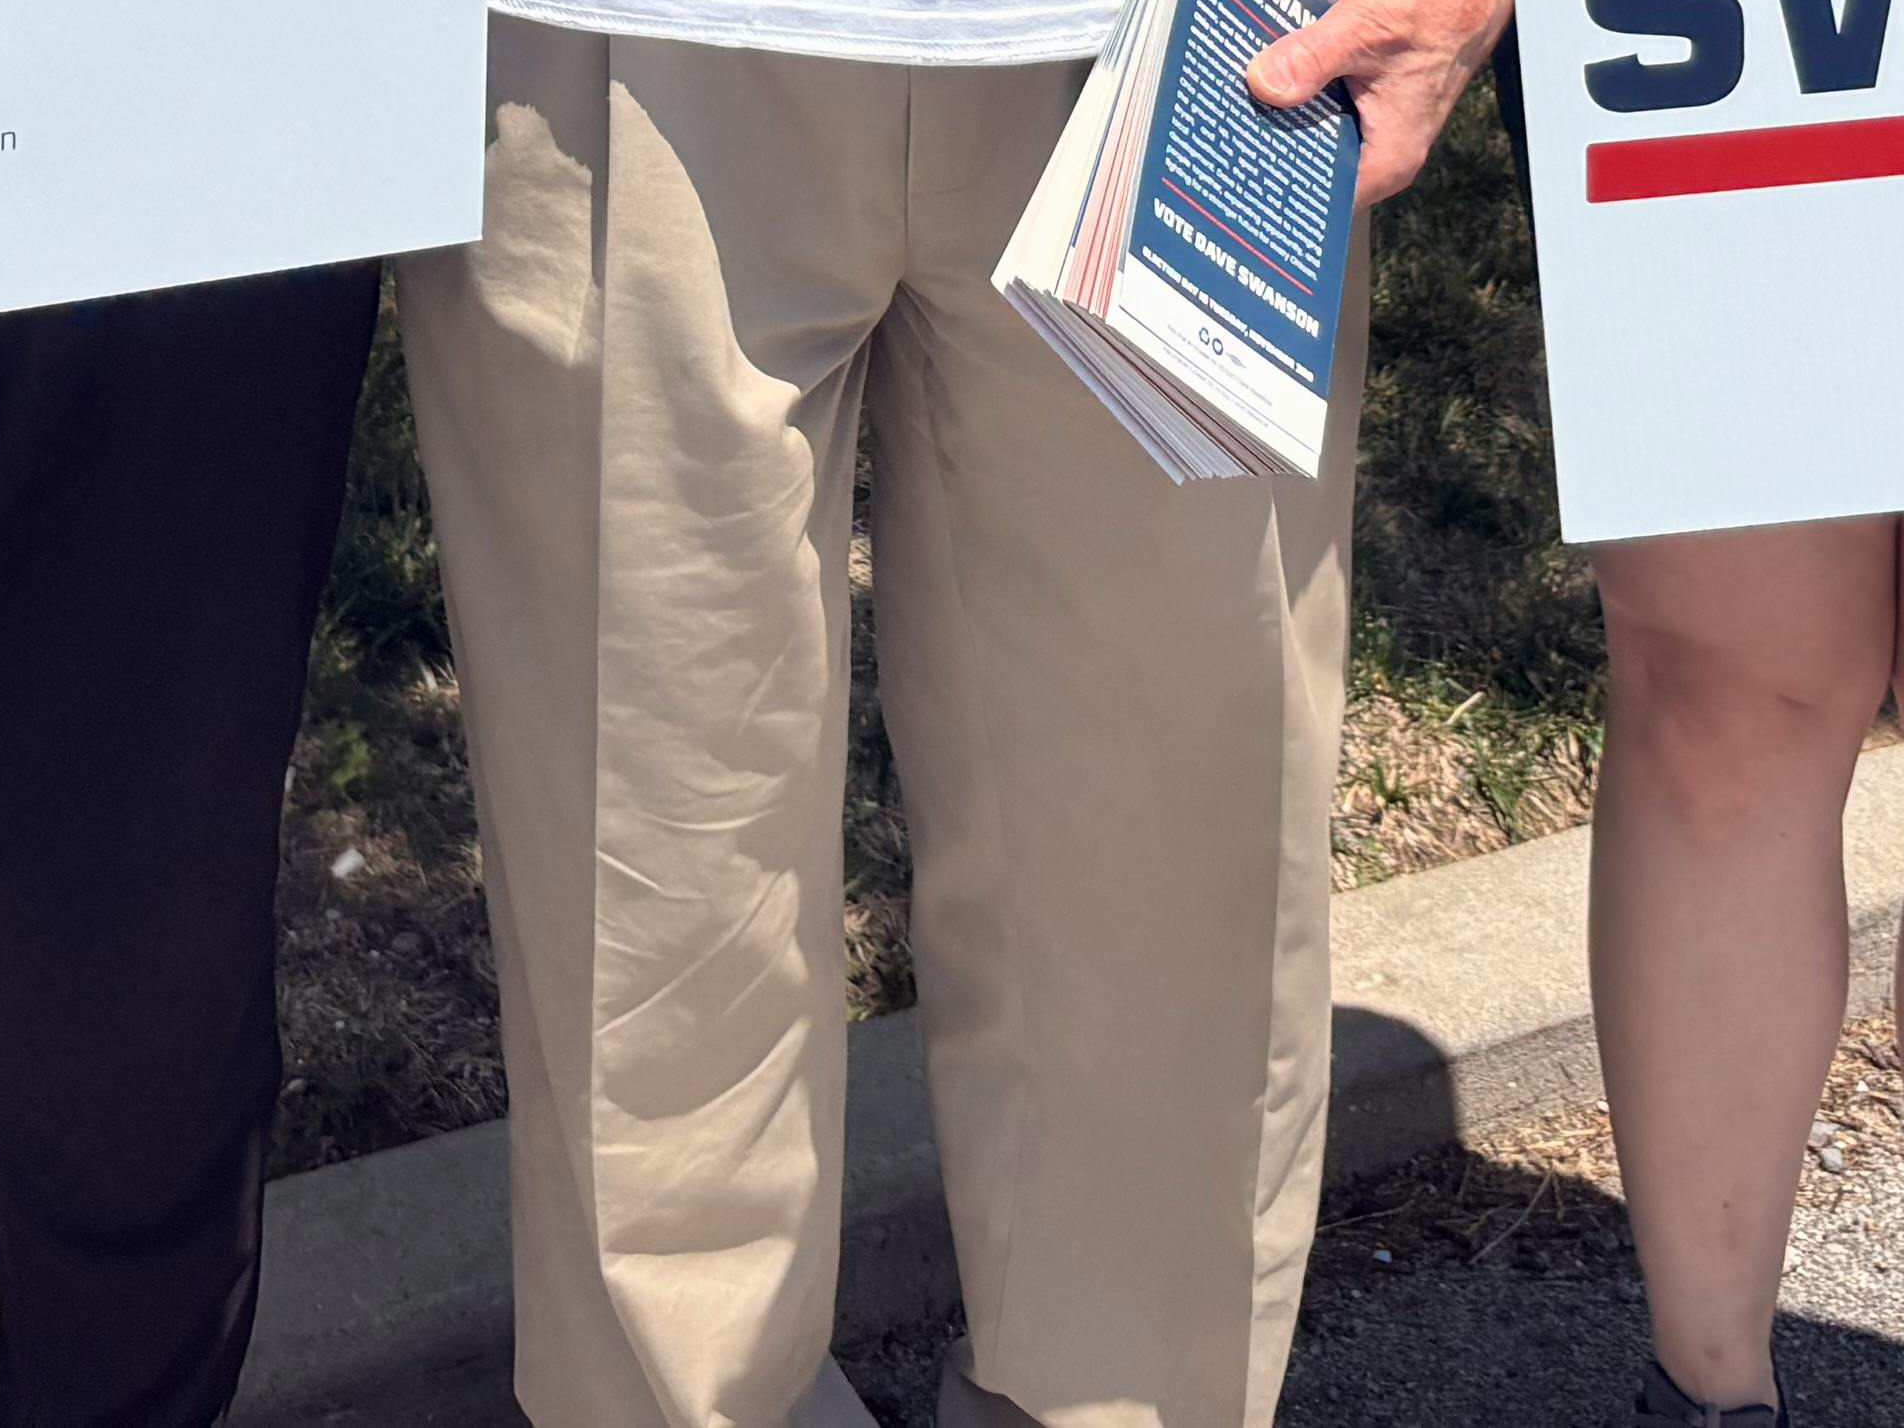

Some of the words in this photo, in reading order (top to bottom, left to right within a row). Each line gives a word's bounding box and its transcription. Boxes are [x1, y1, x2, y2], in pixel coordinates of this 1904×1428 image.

[1154, 198, 1194, 243] VOTE
[1195, 232, 1237, 278] DAVE
[1237, 268, 1320, 338] SWANSON
